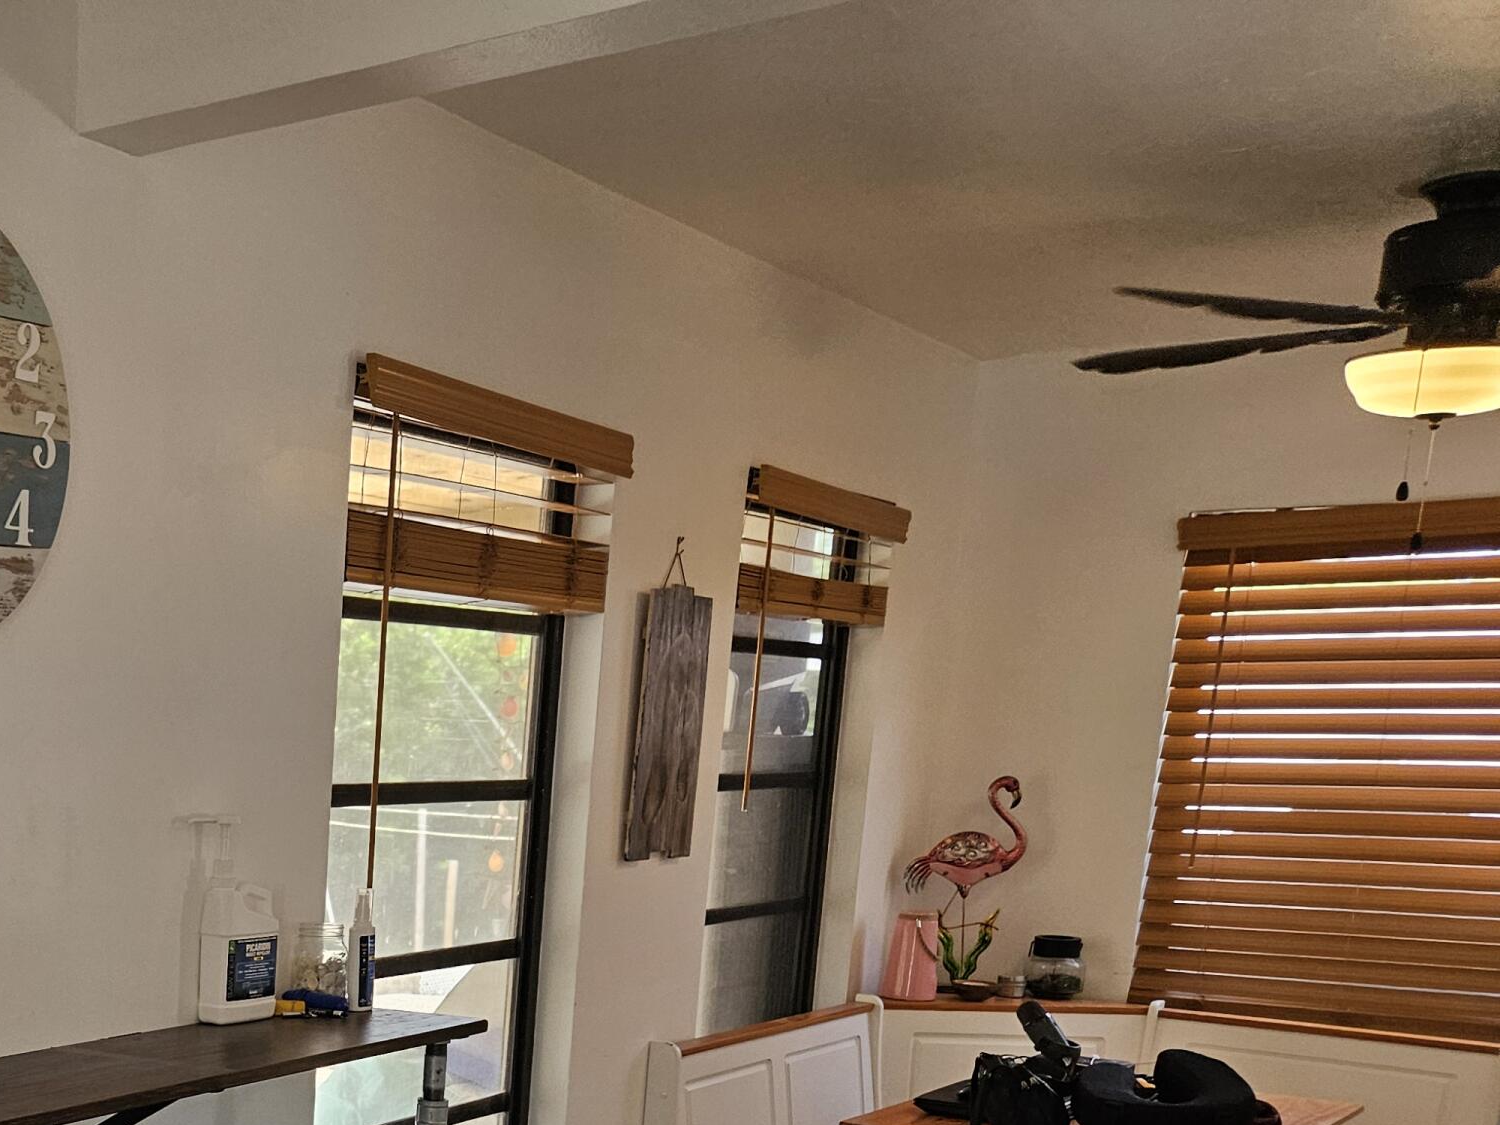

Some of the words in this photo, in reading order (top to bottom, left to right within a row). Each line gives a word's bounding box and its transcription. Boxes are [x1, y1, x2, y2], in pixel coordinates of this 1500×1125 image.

[15, 322, 41, 383] 2
[33, 411, 56, 469] 3
[4, 489, 34, 547] 4
